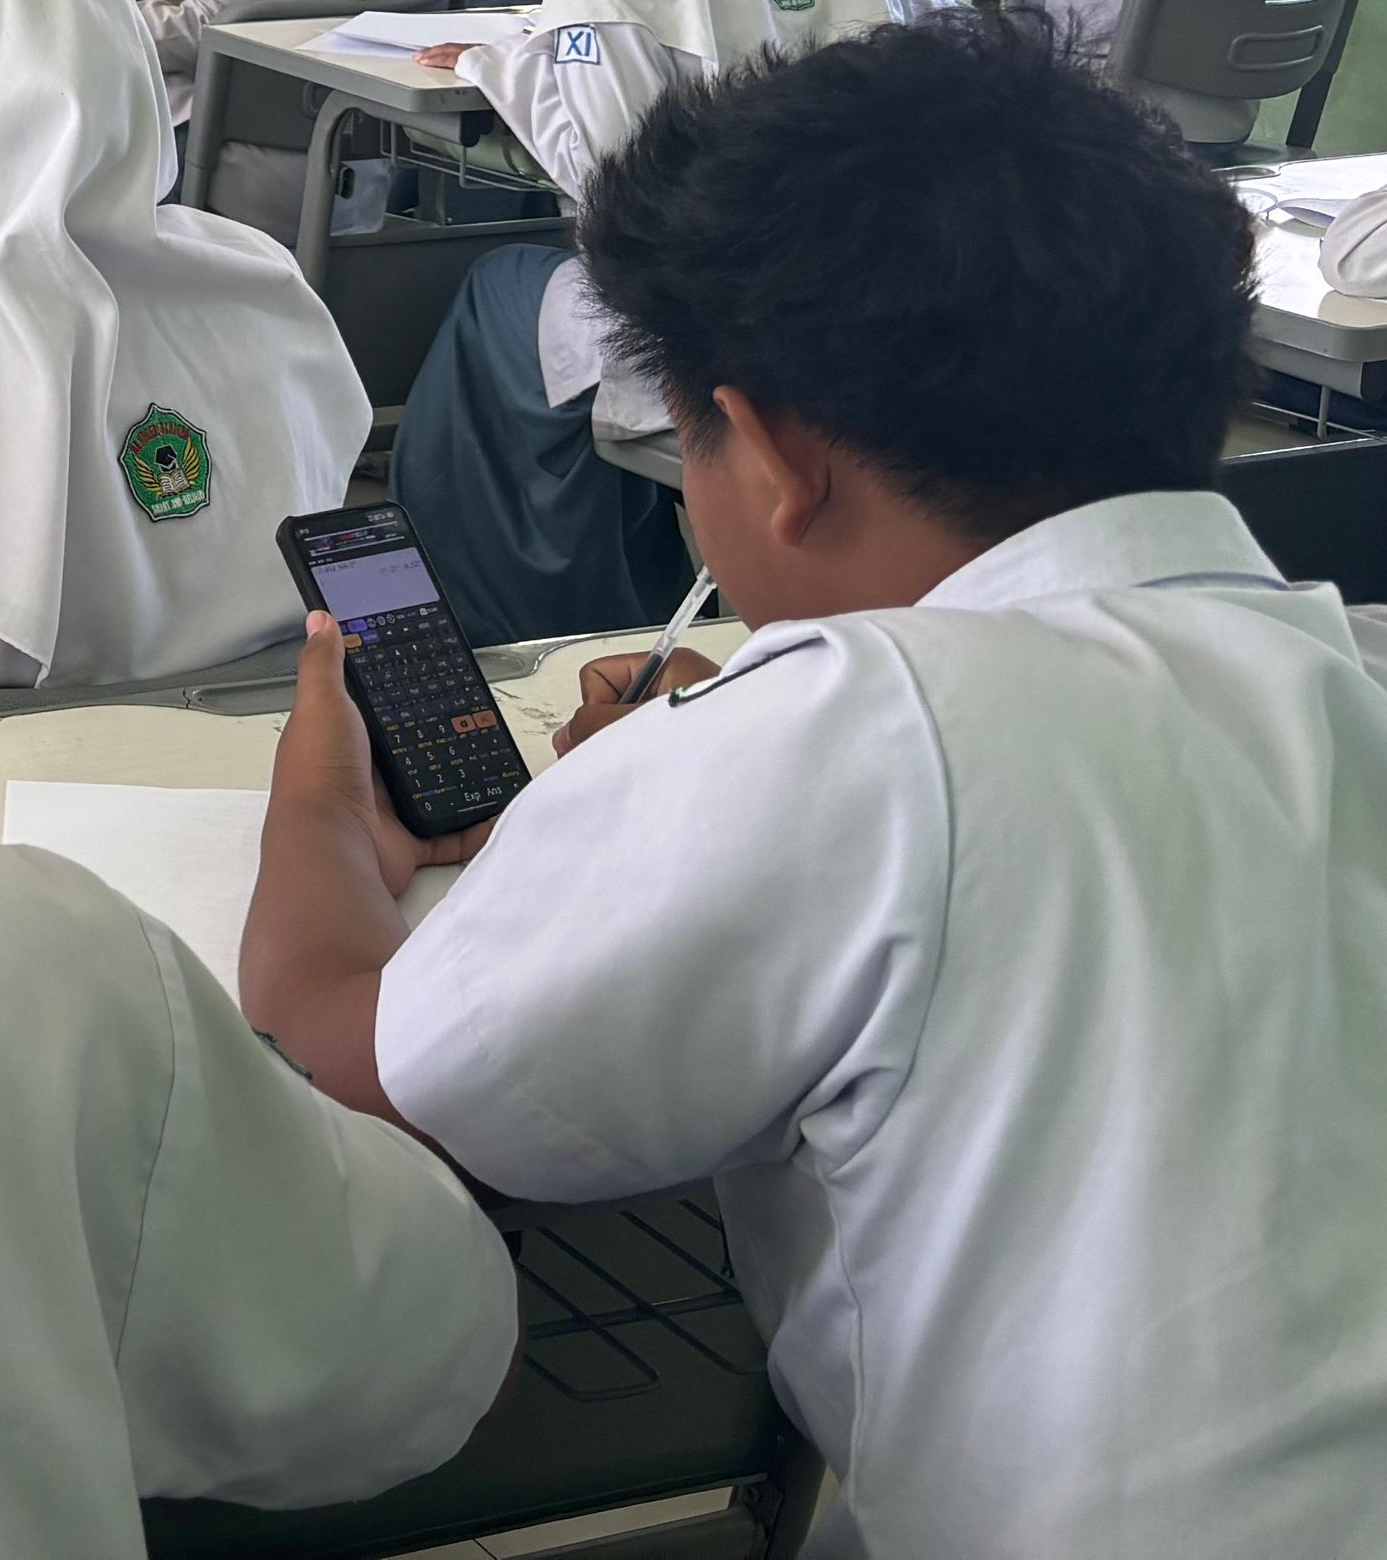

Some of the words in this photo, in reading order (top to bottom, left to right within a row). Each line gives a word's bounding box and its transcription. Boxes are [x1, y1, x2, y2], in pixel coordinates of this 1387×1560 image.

[566, 31, 591, 56] XI
[464, 791, 481, 802] Exp
[487, 786, 503, 796] Ans
